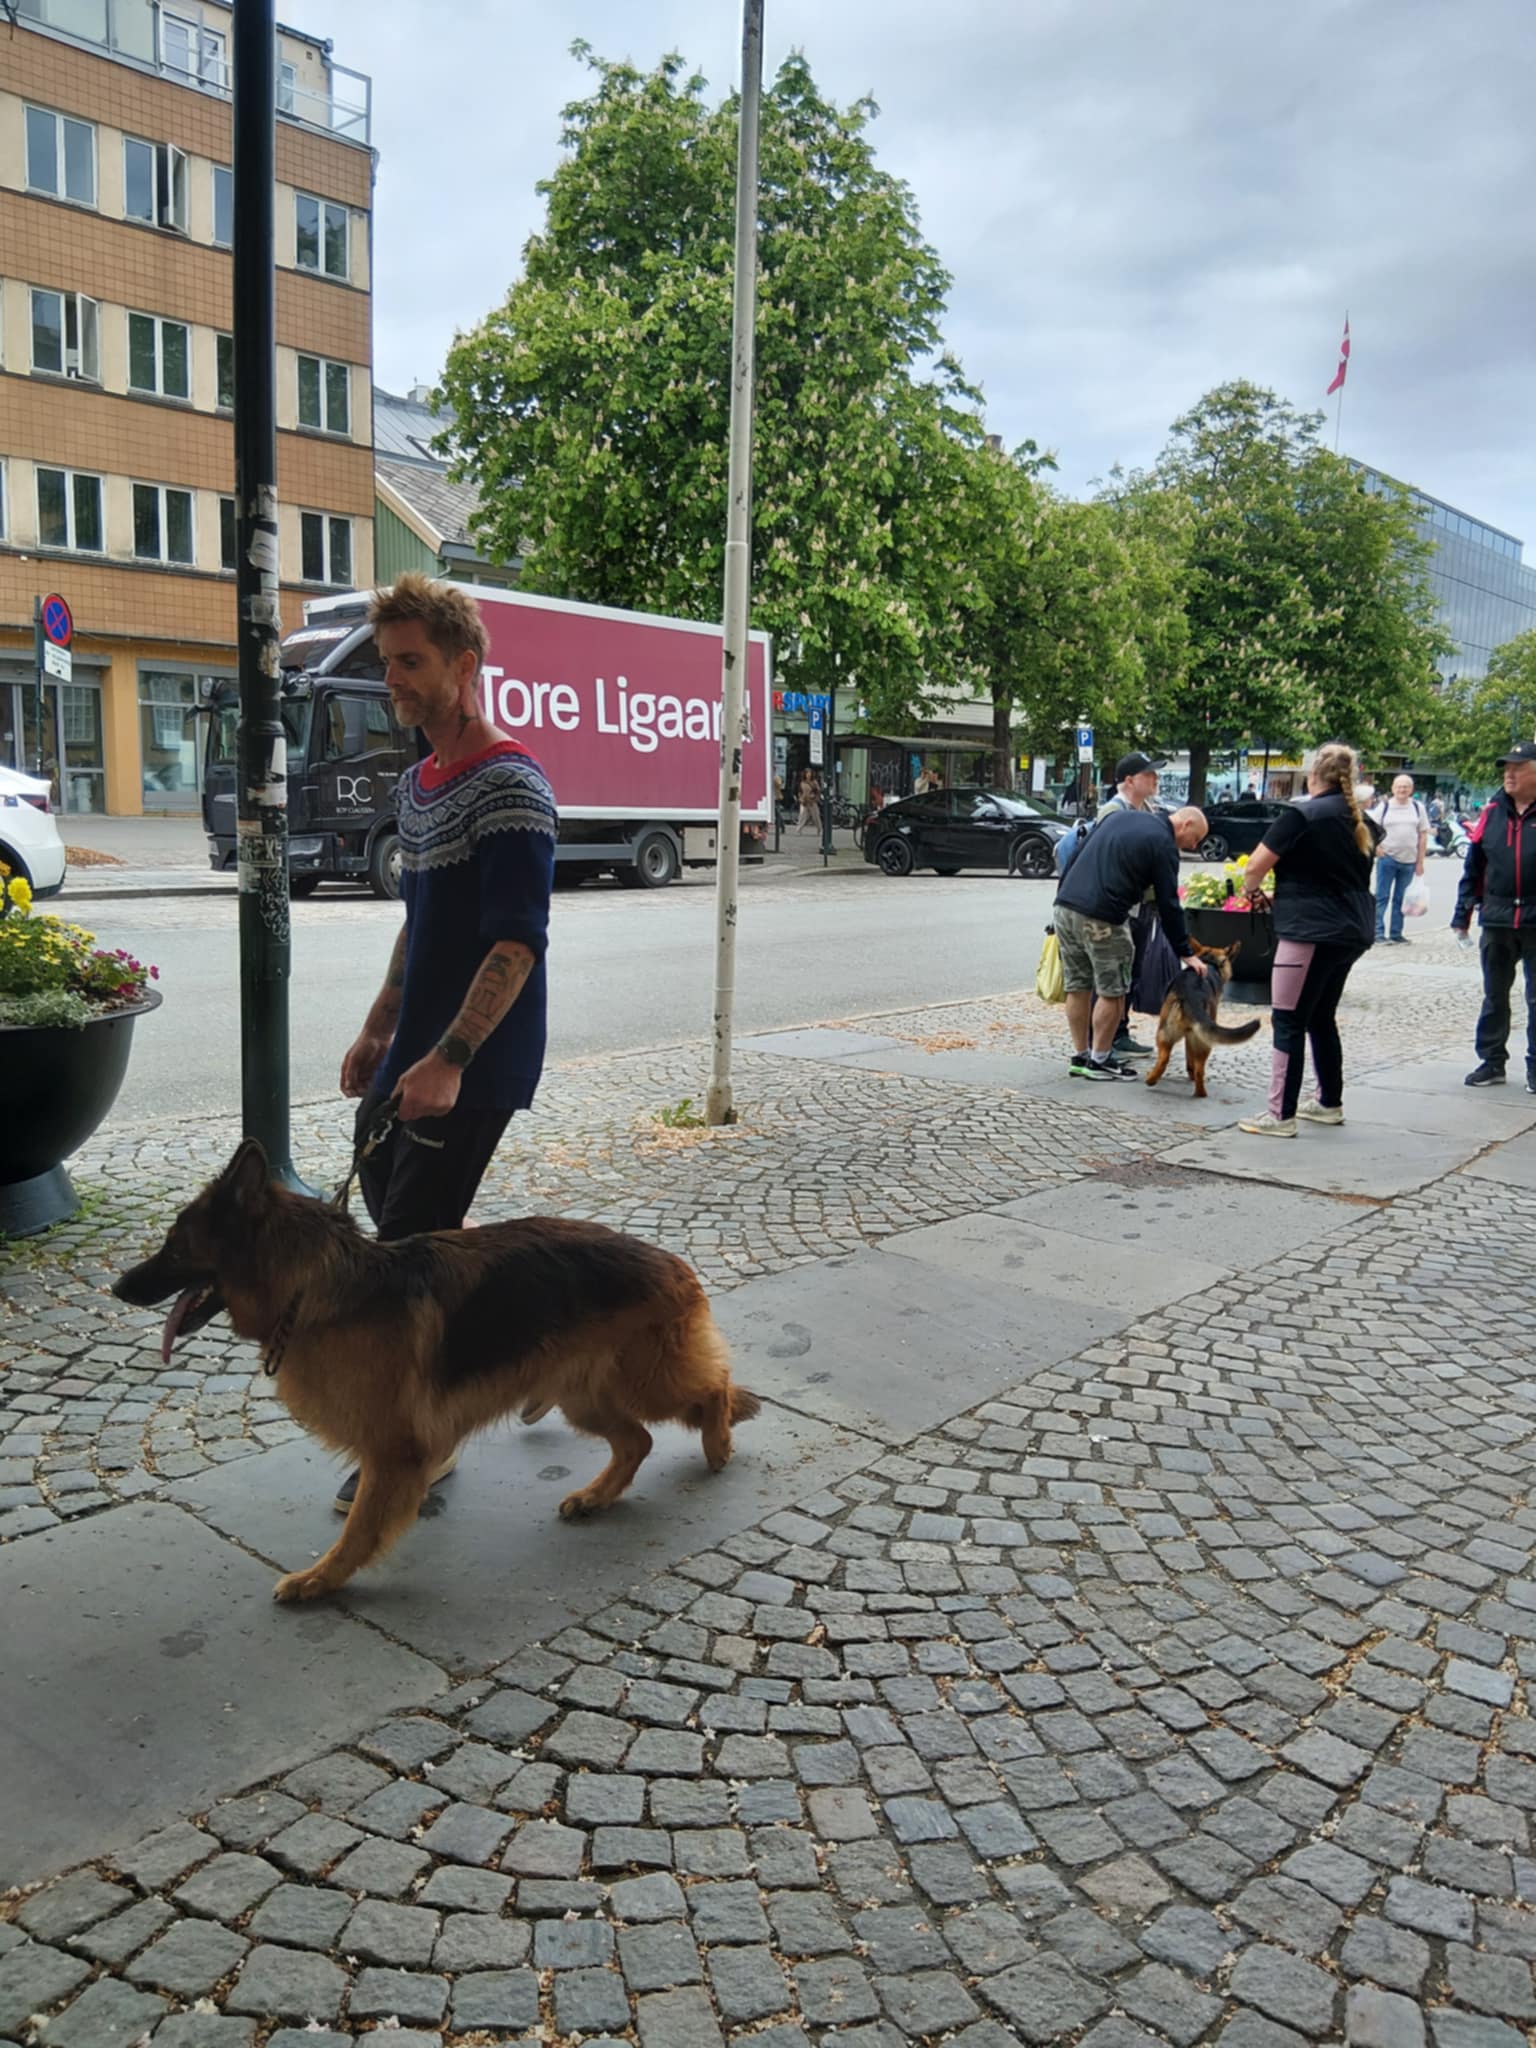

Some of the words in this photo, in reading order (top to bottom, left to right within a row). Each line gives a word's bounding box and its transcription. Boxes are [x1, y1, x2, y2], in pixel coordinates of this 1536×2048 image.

[481, 665, 580, 731] Tore
[595, 675, 751, 753] Ligaar
[812, 710, 821, 728] P
[1081, 731, 1089, 745] P
[336, 775, 372, 806] RC
